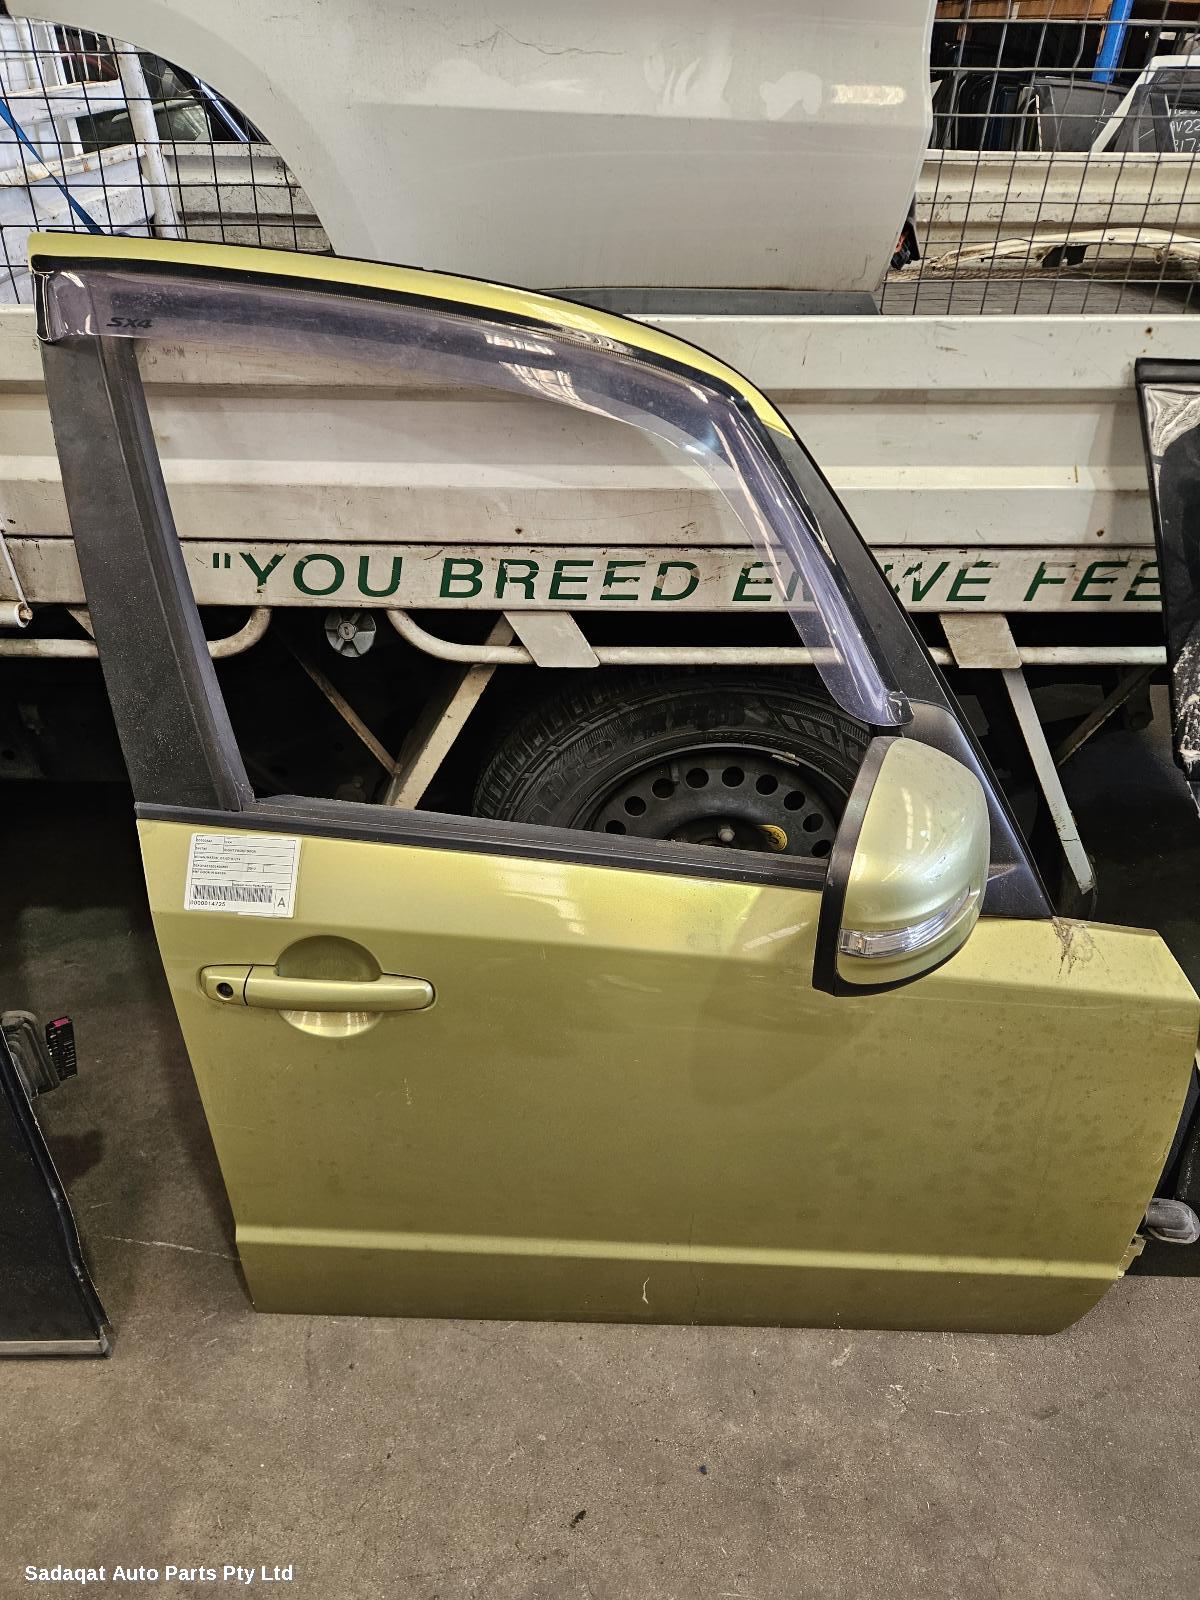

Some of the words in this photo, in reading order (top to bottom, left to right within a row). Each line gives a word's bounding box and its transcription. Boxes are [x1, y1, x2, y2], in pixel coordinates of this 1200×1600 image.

[106, 317, 153, 328] SX4
[213, 553, 403, 597] "YOU
[439, 558, 701, 601] BREED
[278, 897, 286, 908] A
